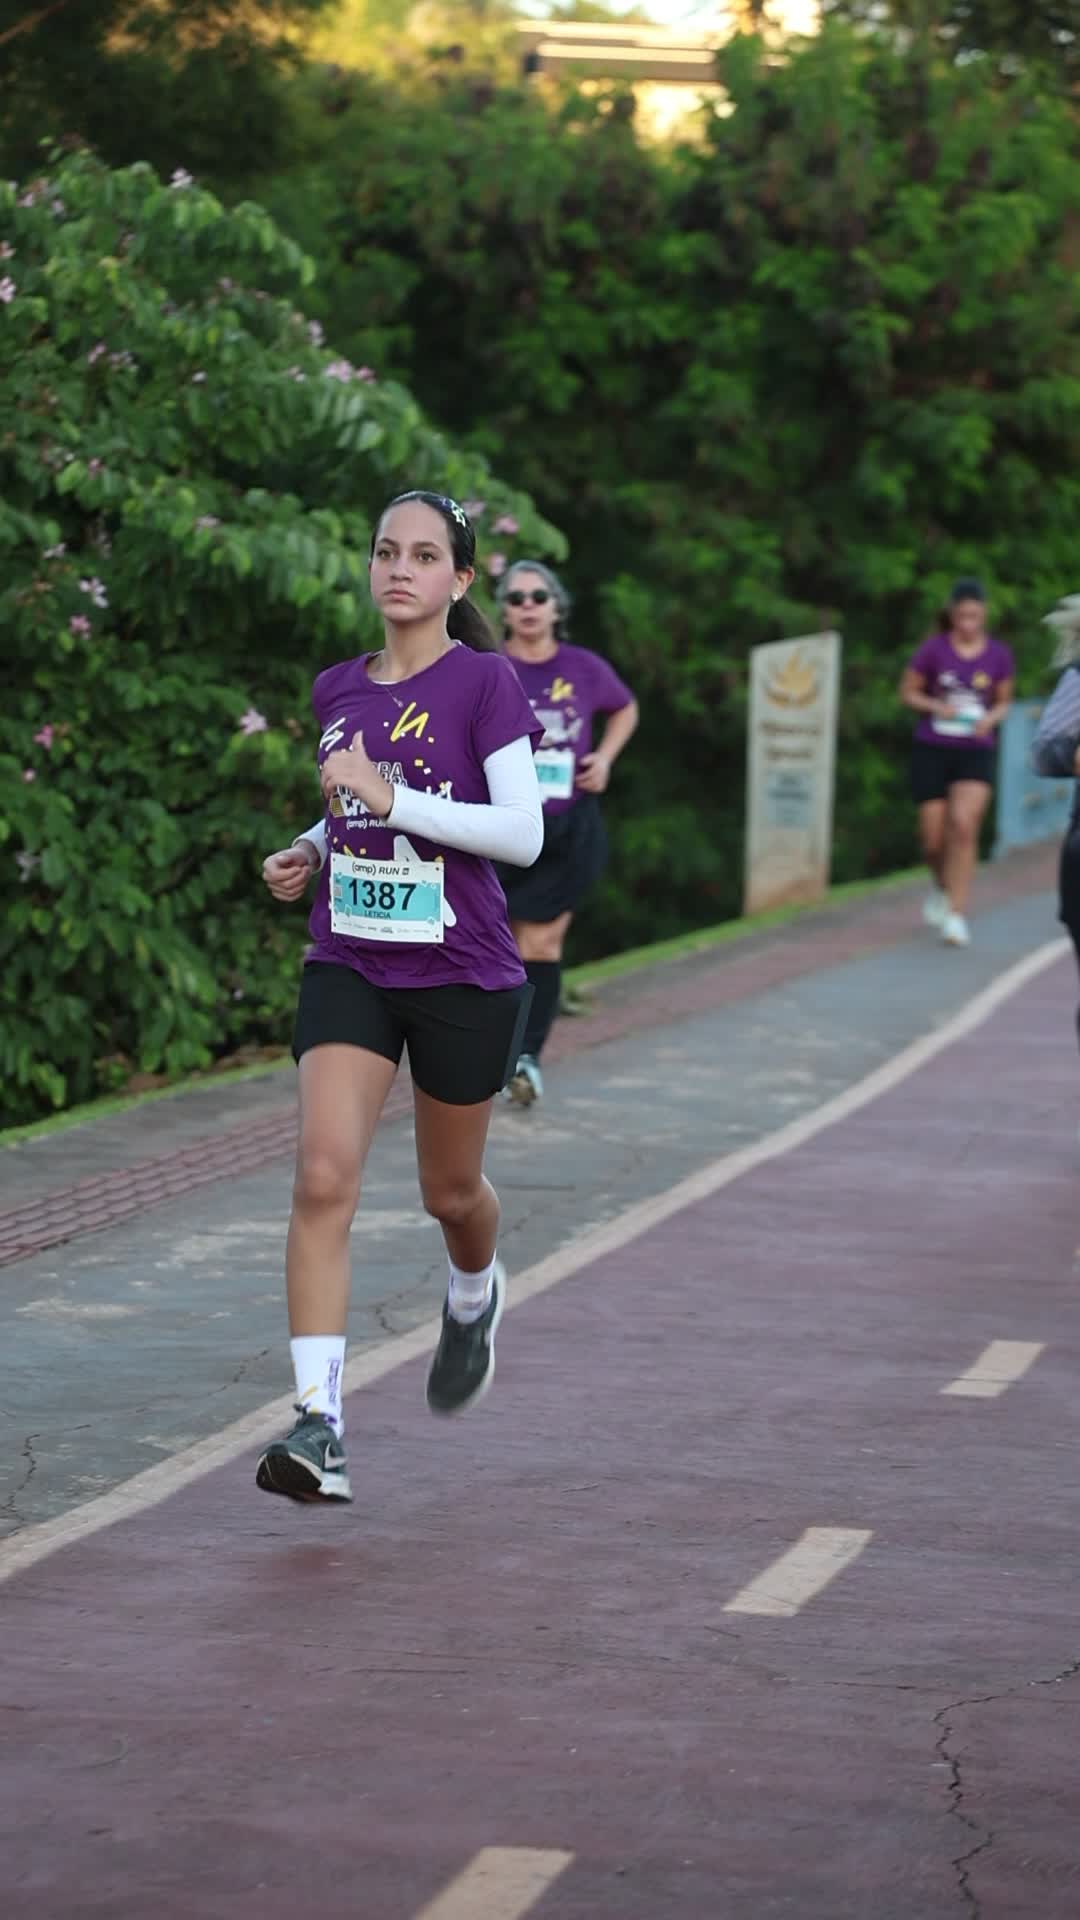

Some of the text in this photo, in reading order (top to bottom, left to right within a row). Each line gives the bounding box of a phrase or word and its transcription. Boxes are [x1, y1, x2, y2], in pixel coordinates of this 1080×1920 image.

[352, 862, 400, 876] (amp) RUN
[348, 878, 417, 911] 1387
[364, 910, 392, 920] LETICIA
